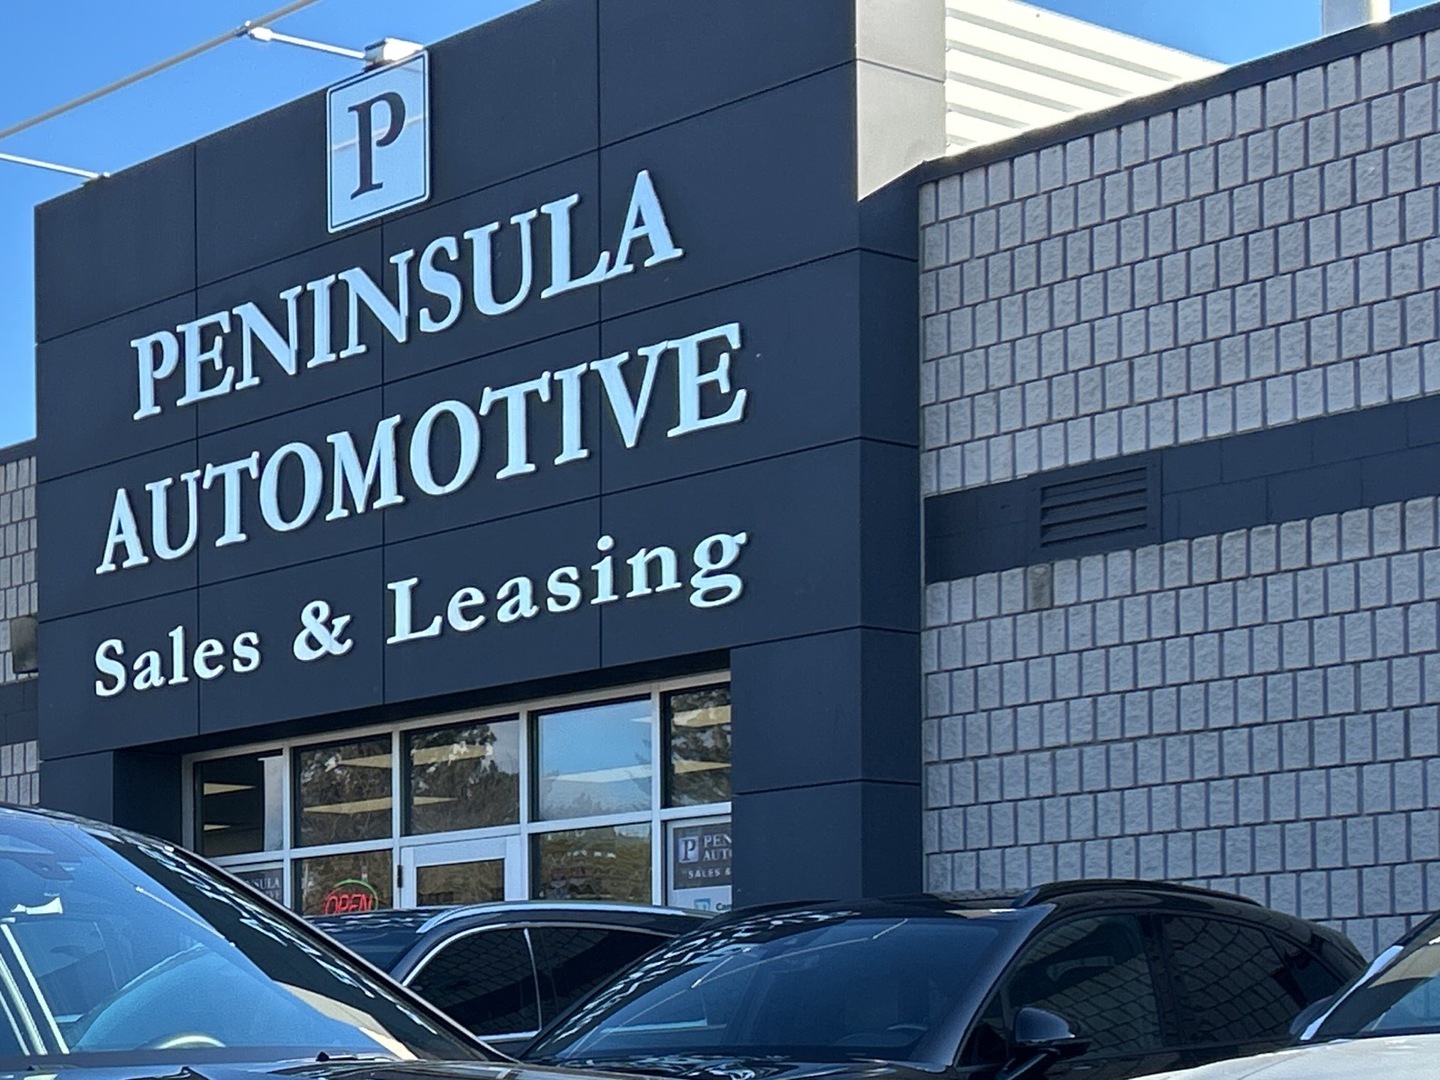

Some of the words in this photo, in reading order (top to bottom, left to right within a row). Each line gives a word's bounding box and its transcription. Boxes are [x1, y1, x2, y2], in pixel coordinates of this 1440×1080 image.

[348, 92, 406, 199] P
[131, 169, 683, 421] PENINSULA
[95, 322, 747, 574] AUTOMOTIVE
[95, 625, 260, 697] Sales
[293, 600, 353, 661] &
[386, 531, 747, 645] Leasing
[682, 839, 696, 861] P
[688, 868, 720, 879] SALES
[324, 893, 372, 915] OPEN
